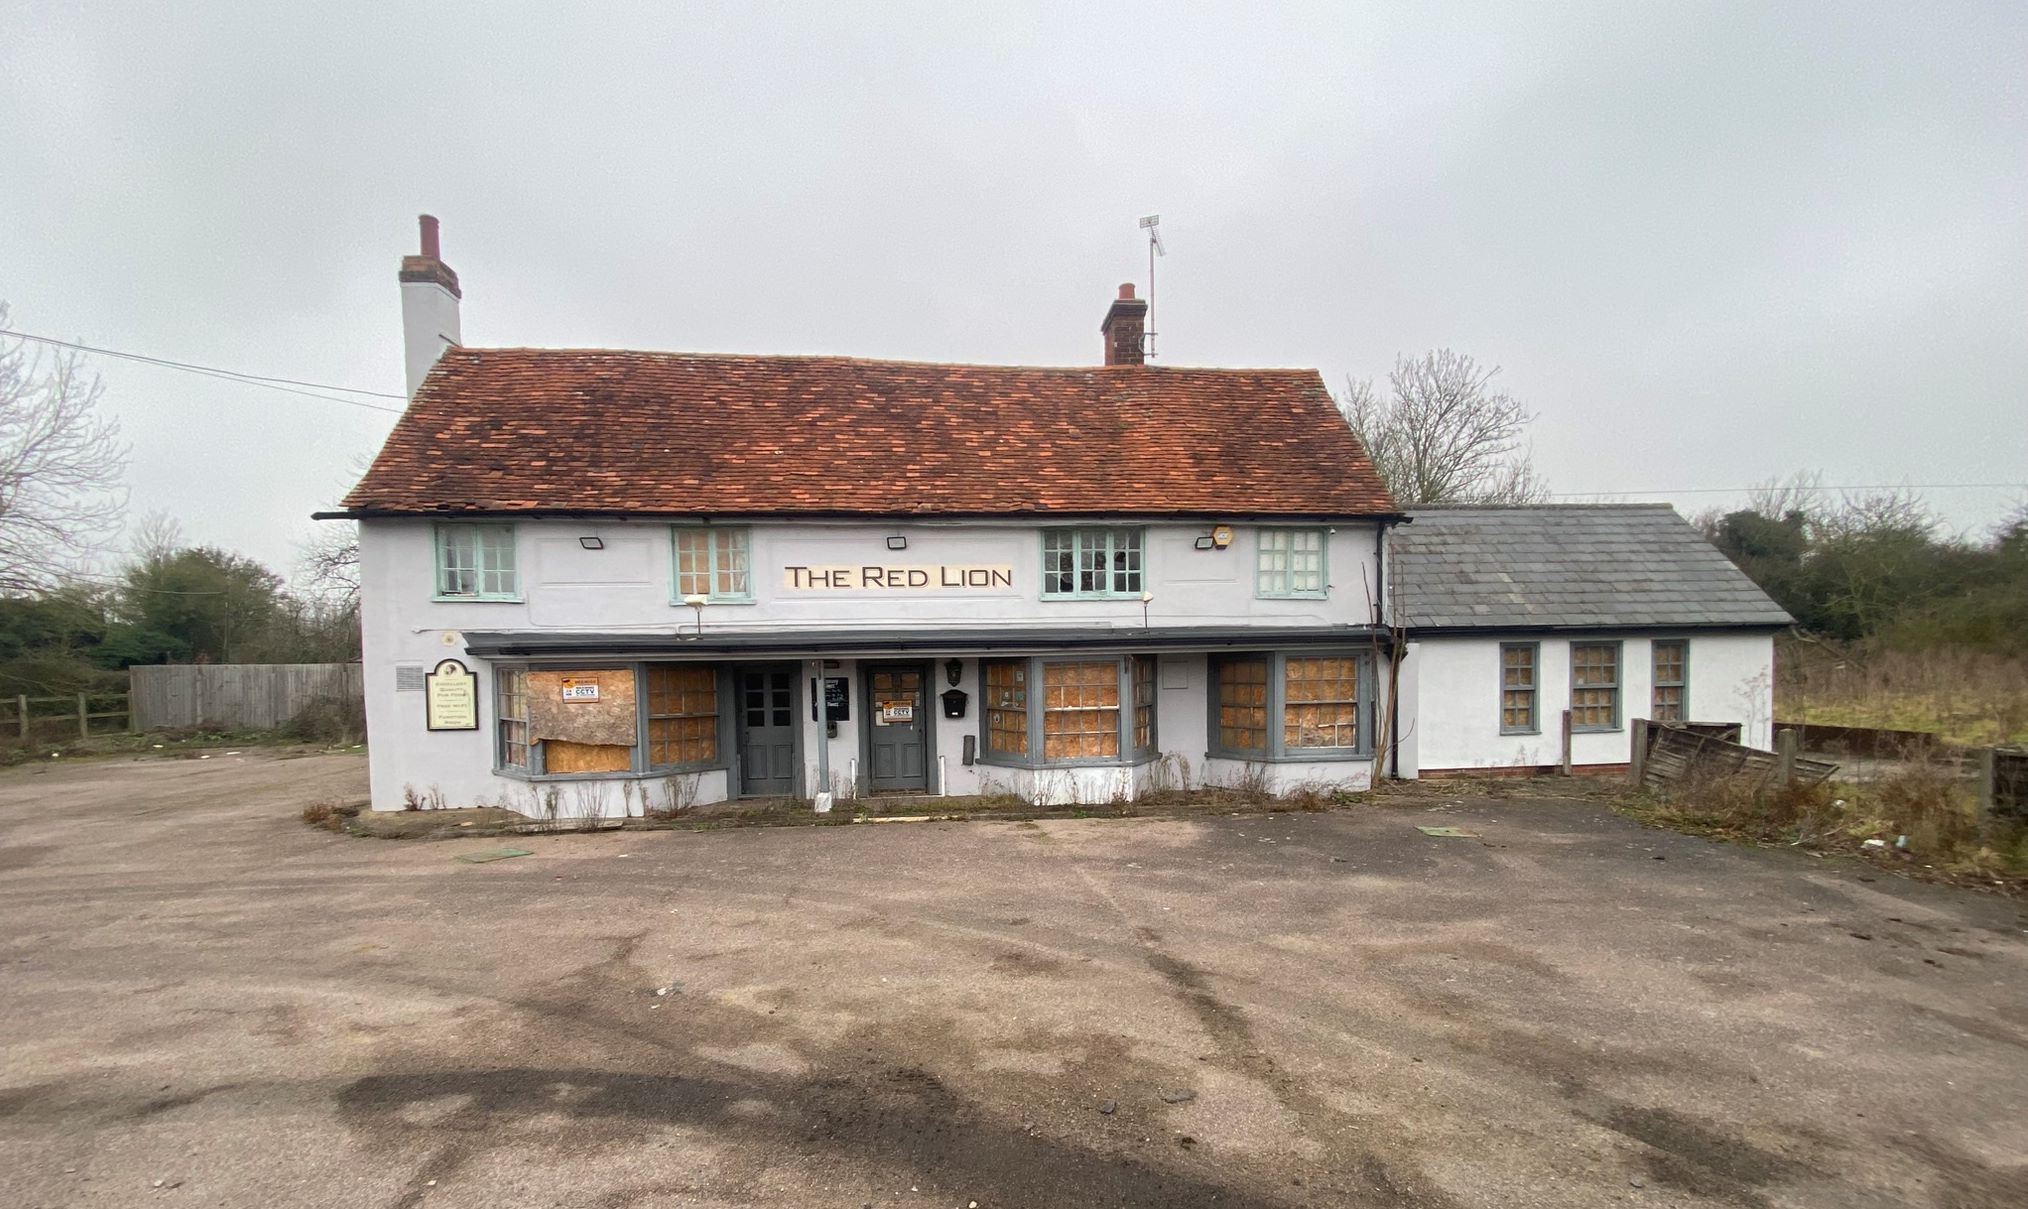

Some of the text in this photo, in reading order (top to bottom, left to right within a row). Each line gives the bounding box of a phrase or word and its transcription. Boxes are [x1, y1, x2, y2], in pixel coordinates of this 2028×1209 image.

[784, 565, 1012, 588] THE RED LION
